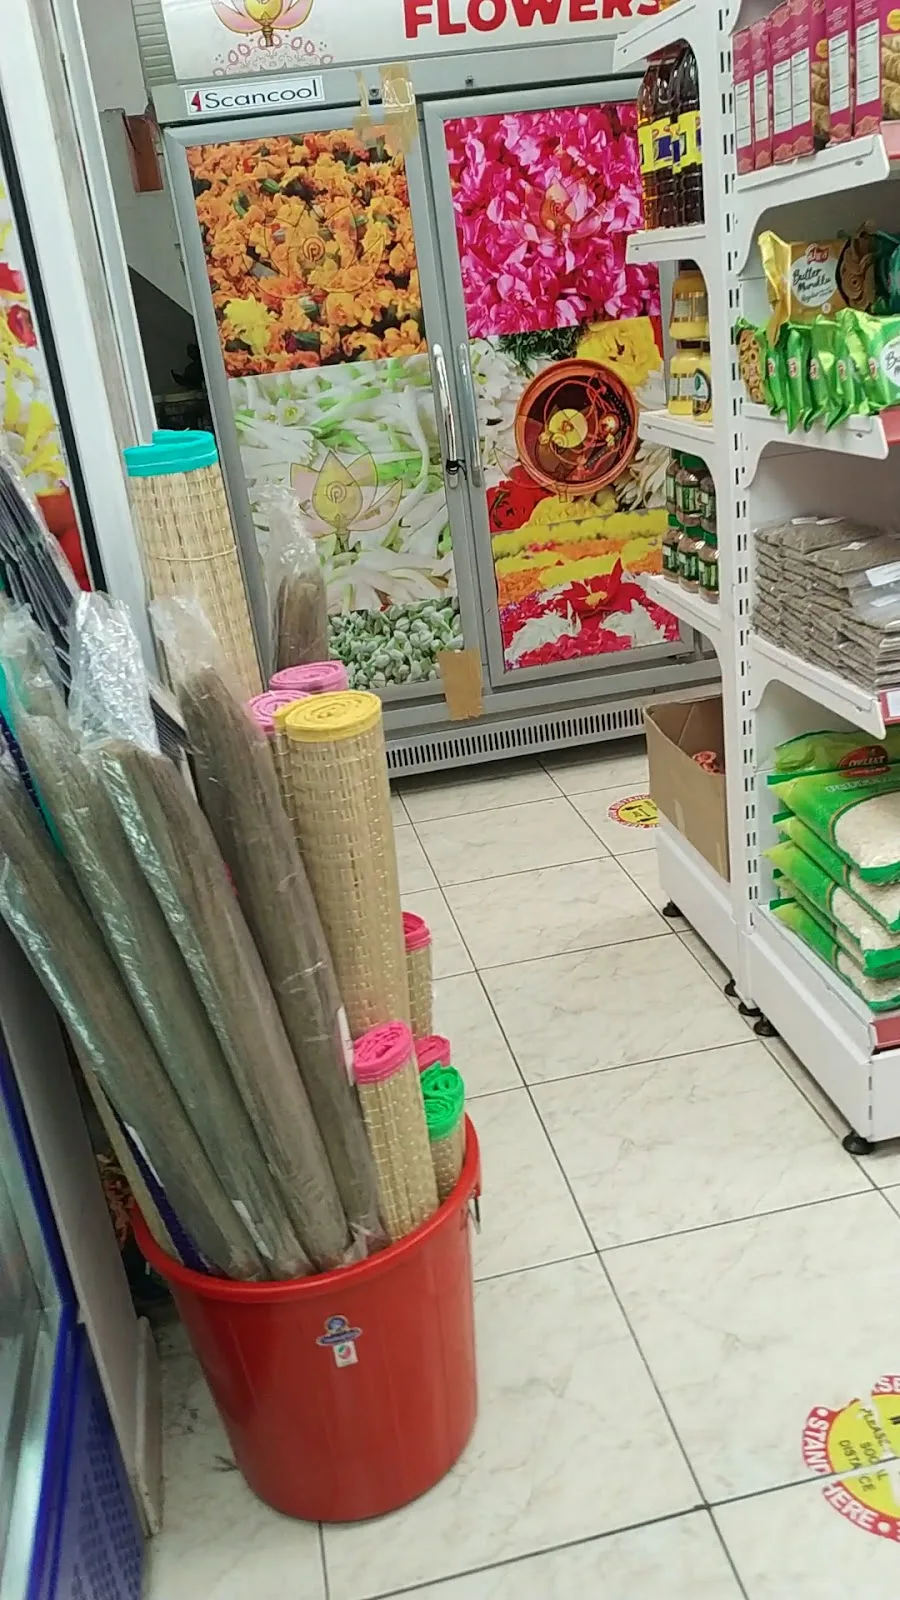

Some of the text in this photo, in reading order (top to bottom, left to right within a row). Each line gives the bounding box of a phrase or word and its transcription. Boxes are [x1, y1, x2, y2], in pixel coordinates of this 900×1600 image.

[205, 79, 318, 109] Scancool
[839, 1439, 876, 1492] DISTACE
[859, 1441, 888, 1481] SOCL
